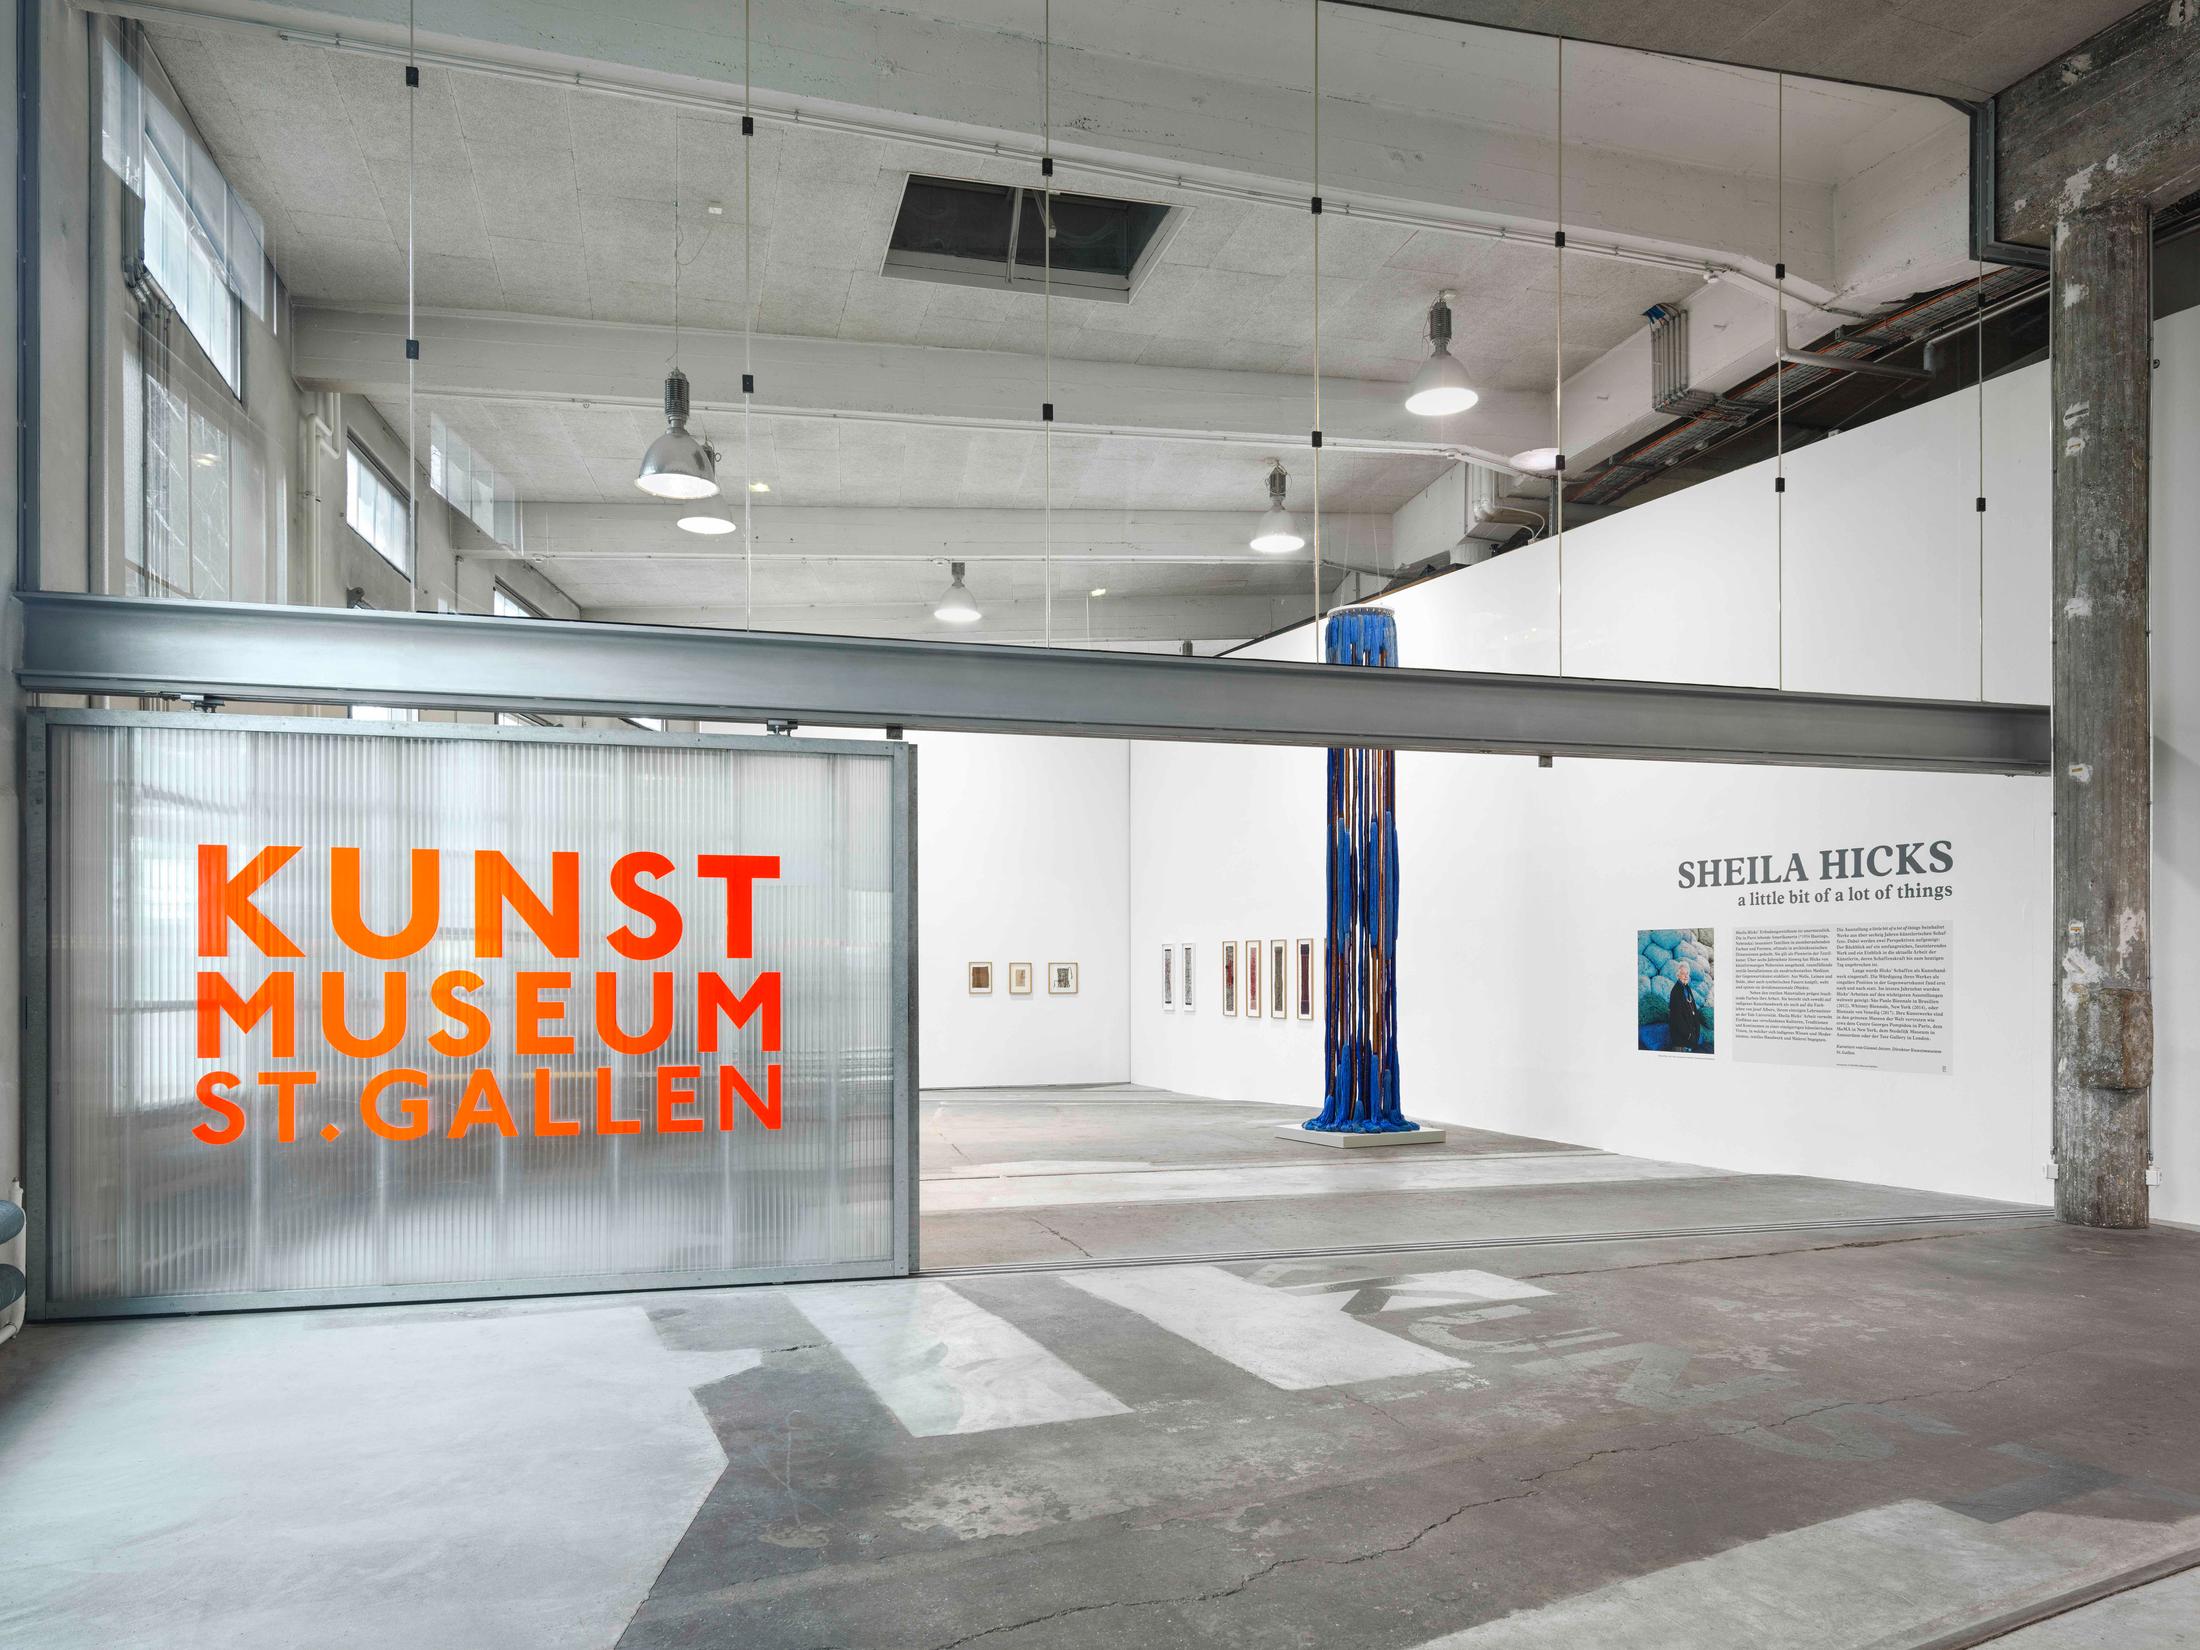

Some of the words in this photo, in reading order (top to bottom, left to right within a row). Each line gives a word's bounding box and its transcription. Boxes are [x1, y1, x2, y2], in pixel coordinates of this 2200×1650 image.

[1677, 852, 1809, 889] SHEILA
[1818, 839, 1955, 881] HICKS
[1737, 894, 1747, 907] a
[1749, 890, 1786, 907] little
[1788, 888, 1811, 905] bit
[1813, 887, 1832, 904] of
[1834, 890, 1845, 903] a
[1847, 886, 1871, 903] lot
[1874, 884, 1894, 901] of
[1896, 882, 1954, 902] things
[197, 844, 782, 961] KUNST
[197, 970, 782, 1059] MUSEUM
